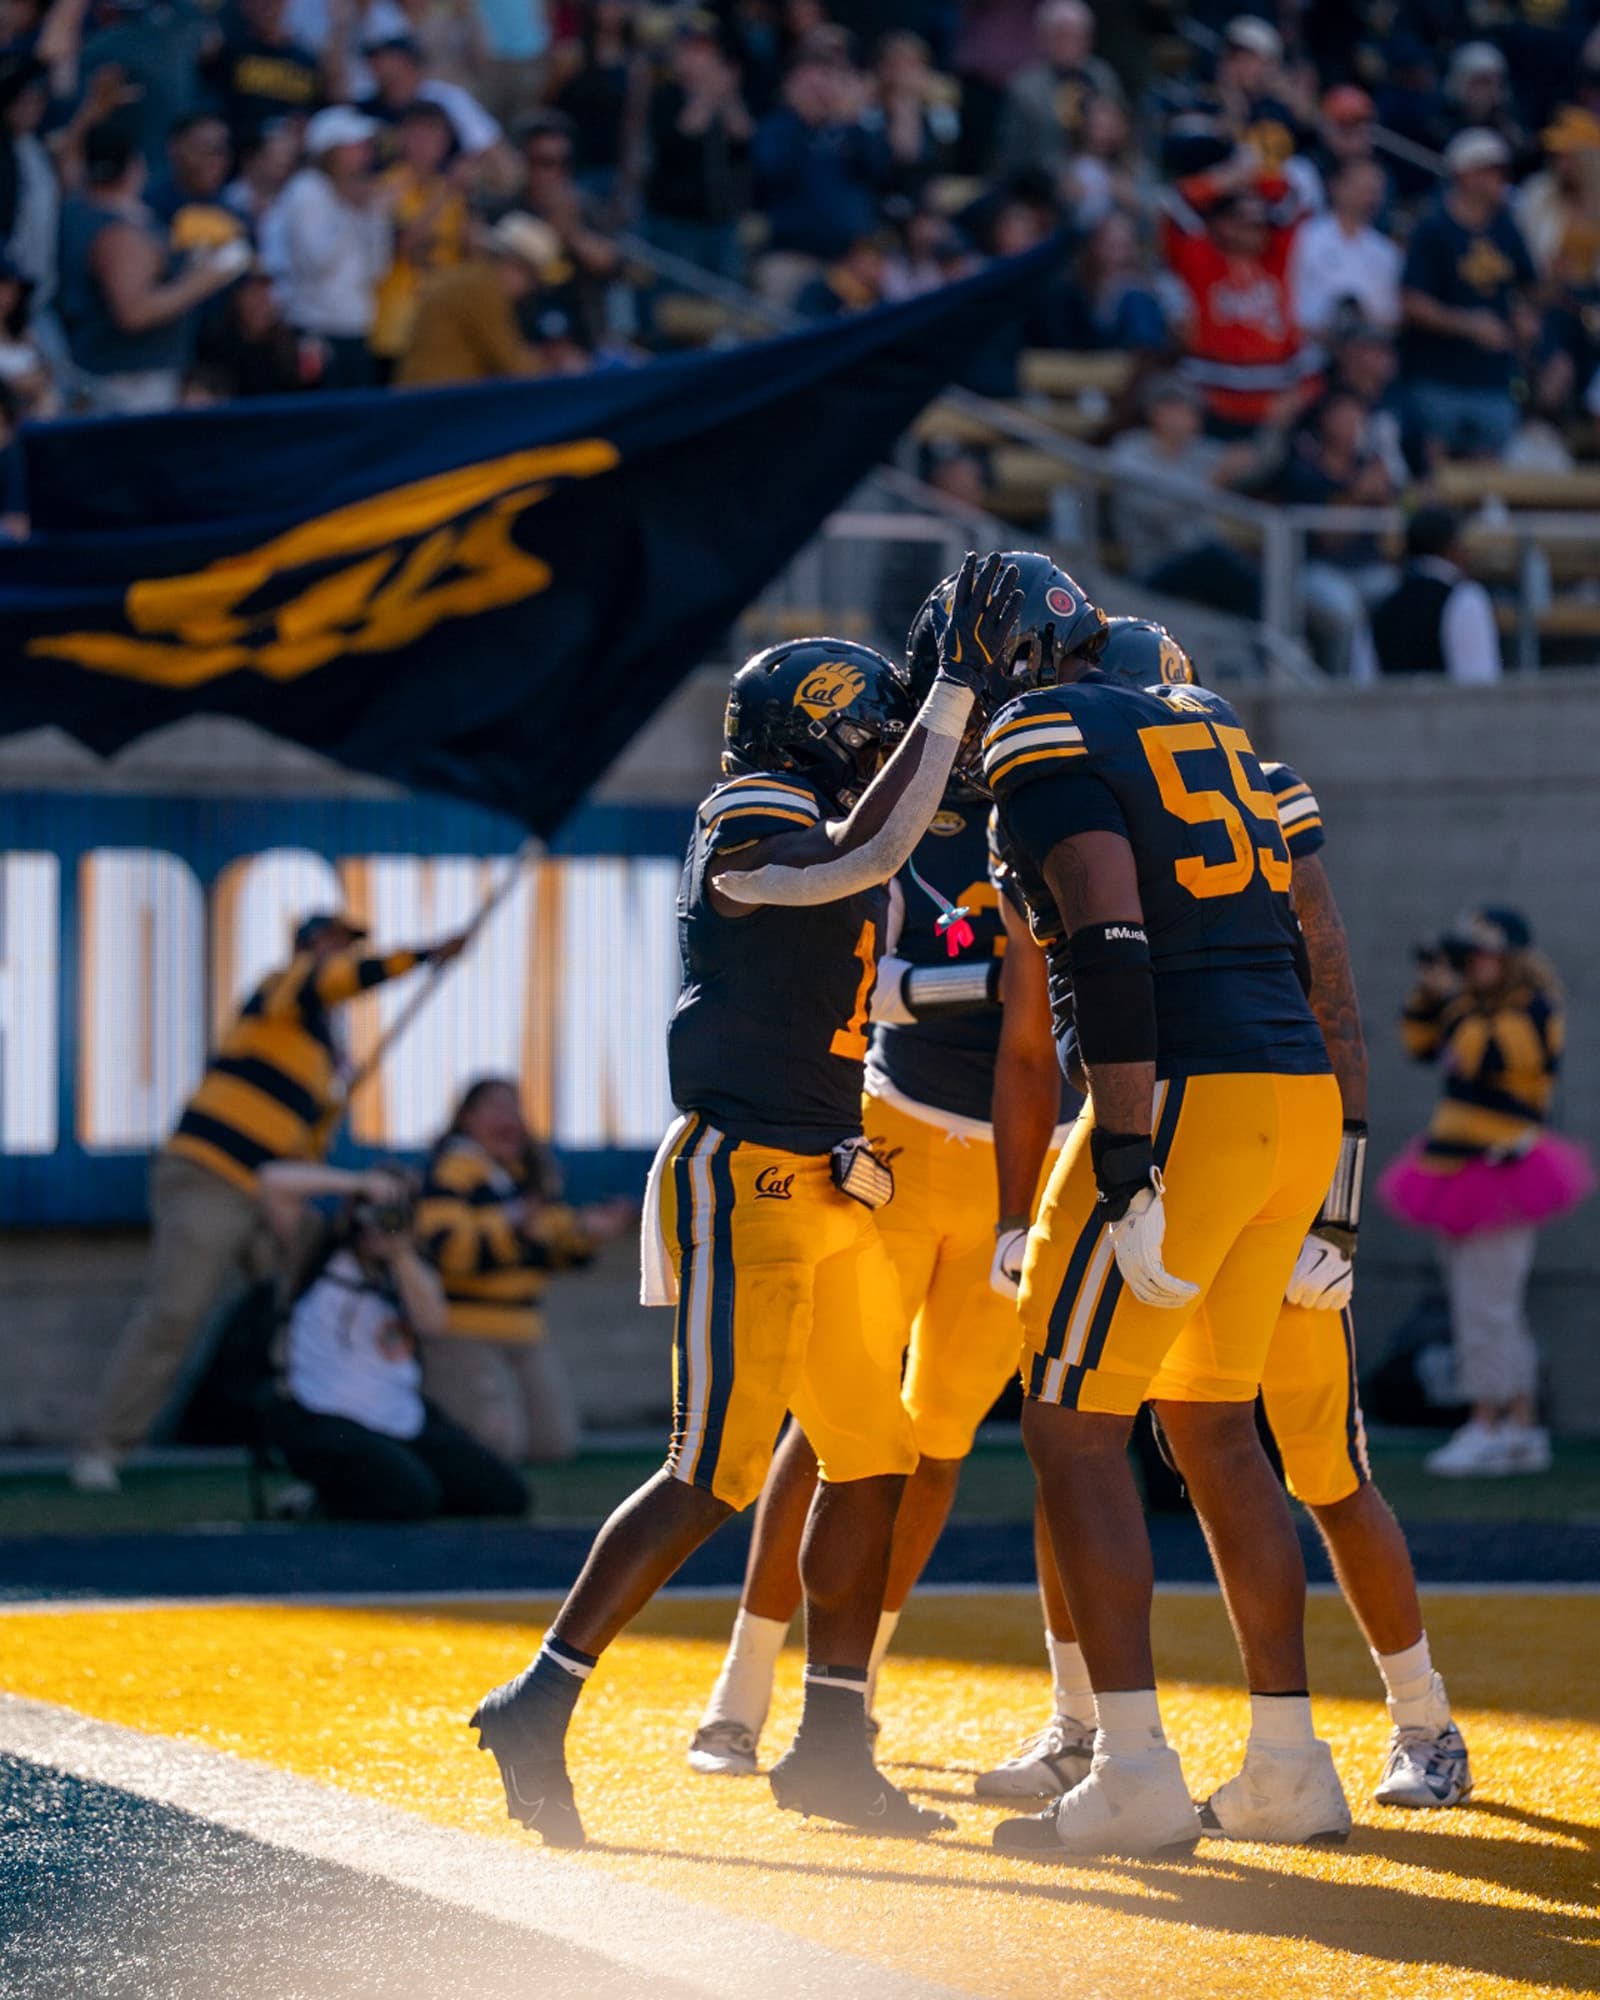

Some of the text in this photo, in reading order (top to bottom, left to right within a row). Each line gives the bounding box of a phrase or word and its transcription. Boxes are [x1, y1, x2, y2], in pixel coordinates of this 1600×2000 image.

[1165, 656, 1188, 684] Cal
[799, 677, 845, 707] Cal
[1137, 721, 1292, 900] 55
[829, 919, 876, 1062] 1
[754, 1166, 795, 1200] Cal
